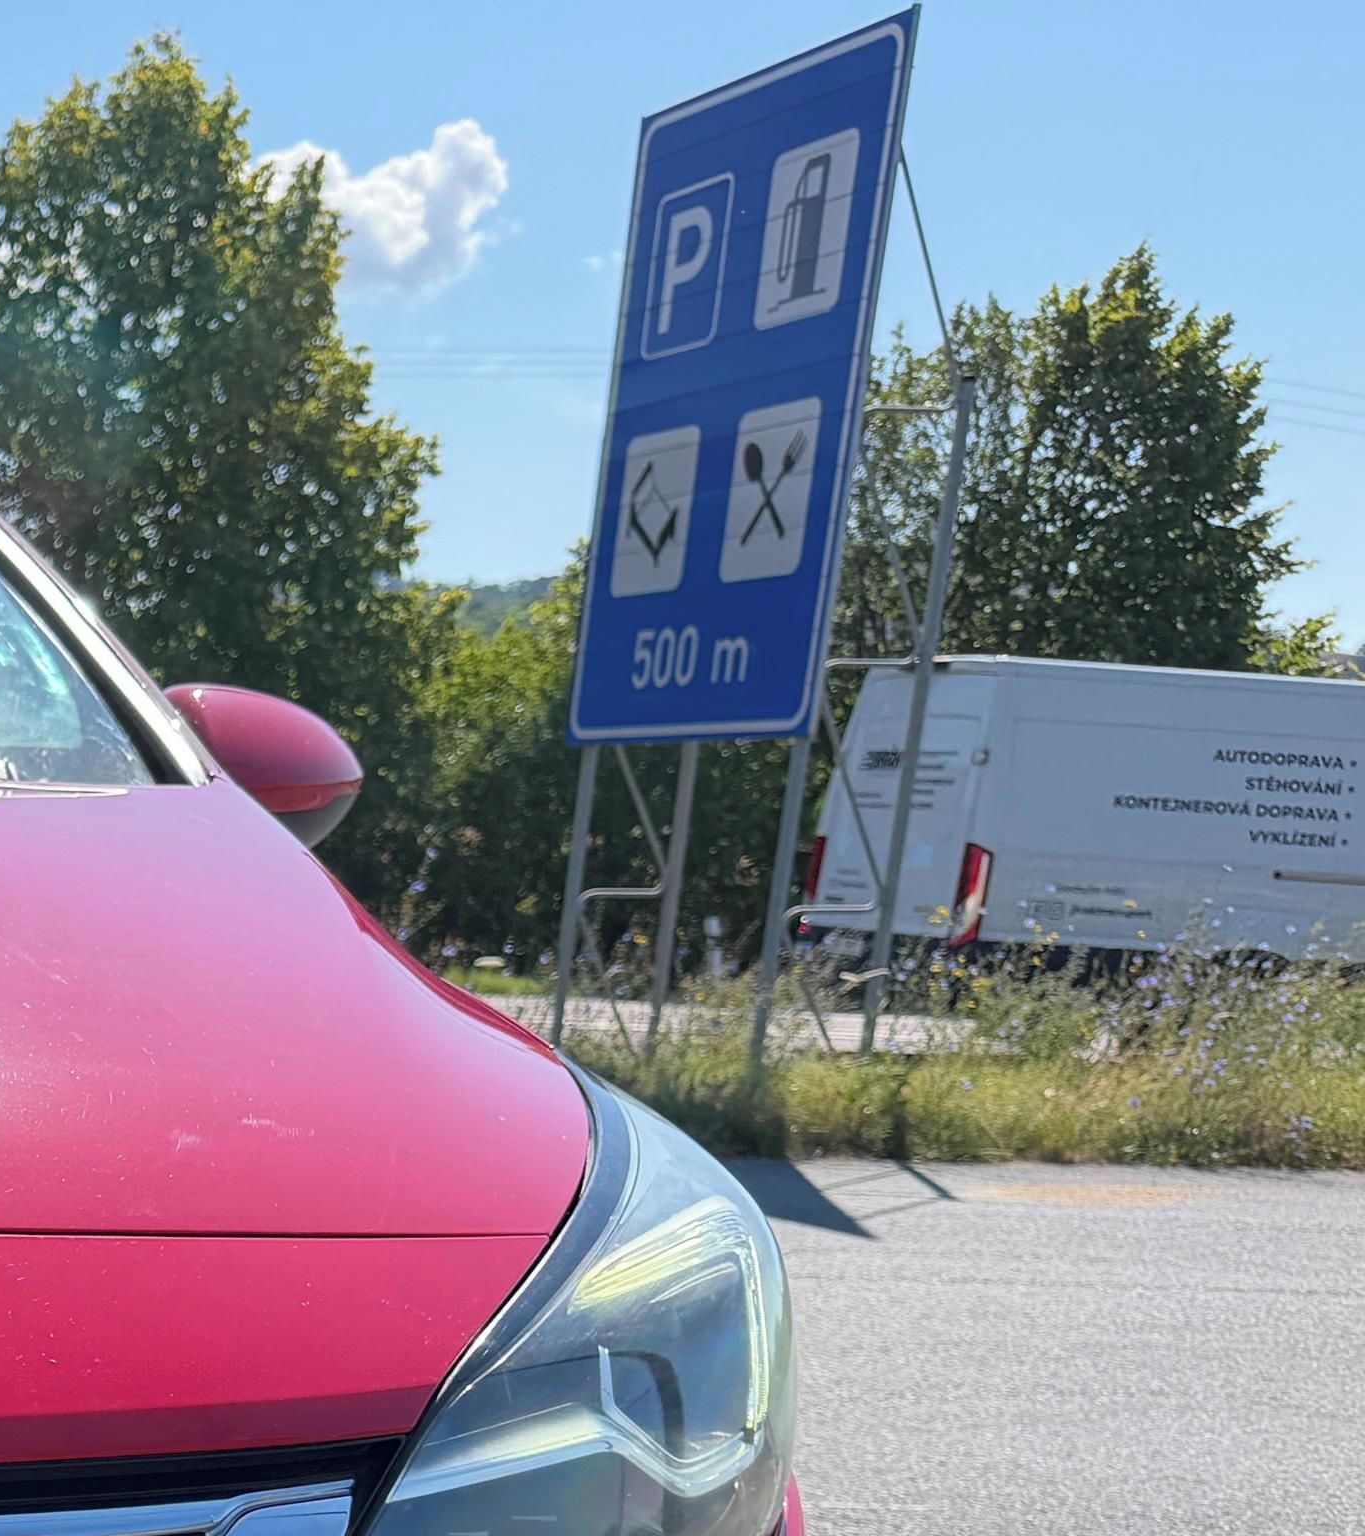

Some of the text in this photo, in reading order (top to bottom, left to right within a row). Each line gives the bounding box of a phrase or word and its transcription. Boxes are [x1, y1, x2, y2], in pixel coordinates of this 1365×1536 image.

[657, 206, 714, 335] P
[631, 624, 749, 690] 500 m
[1213, 750, 1344, 770] AUTODOPRAVA
[1245, 775, 1343, 796] STĚHOVÁNÍ
[1113, 794, 1339, 822] KONTEJNEROVÁ DOPRAVA
[1249, 830, 1337, 848] VYKLÍZENÍ
